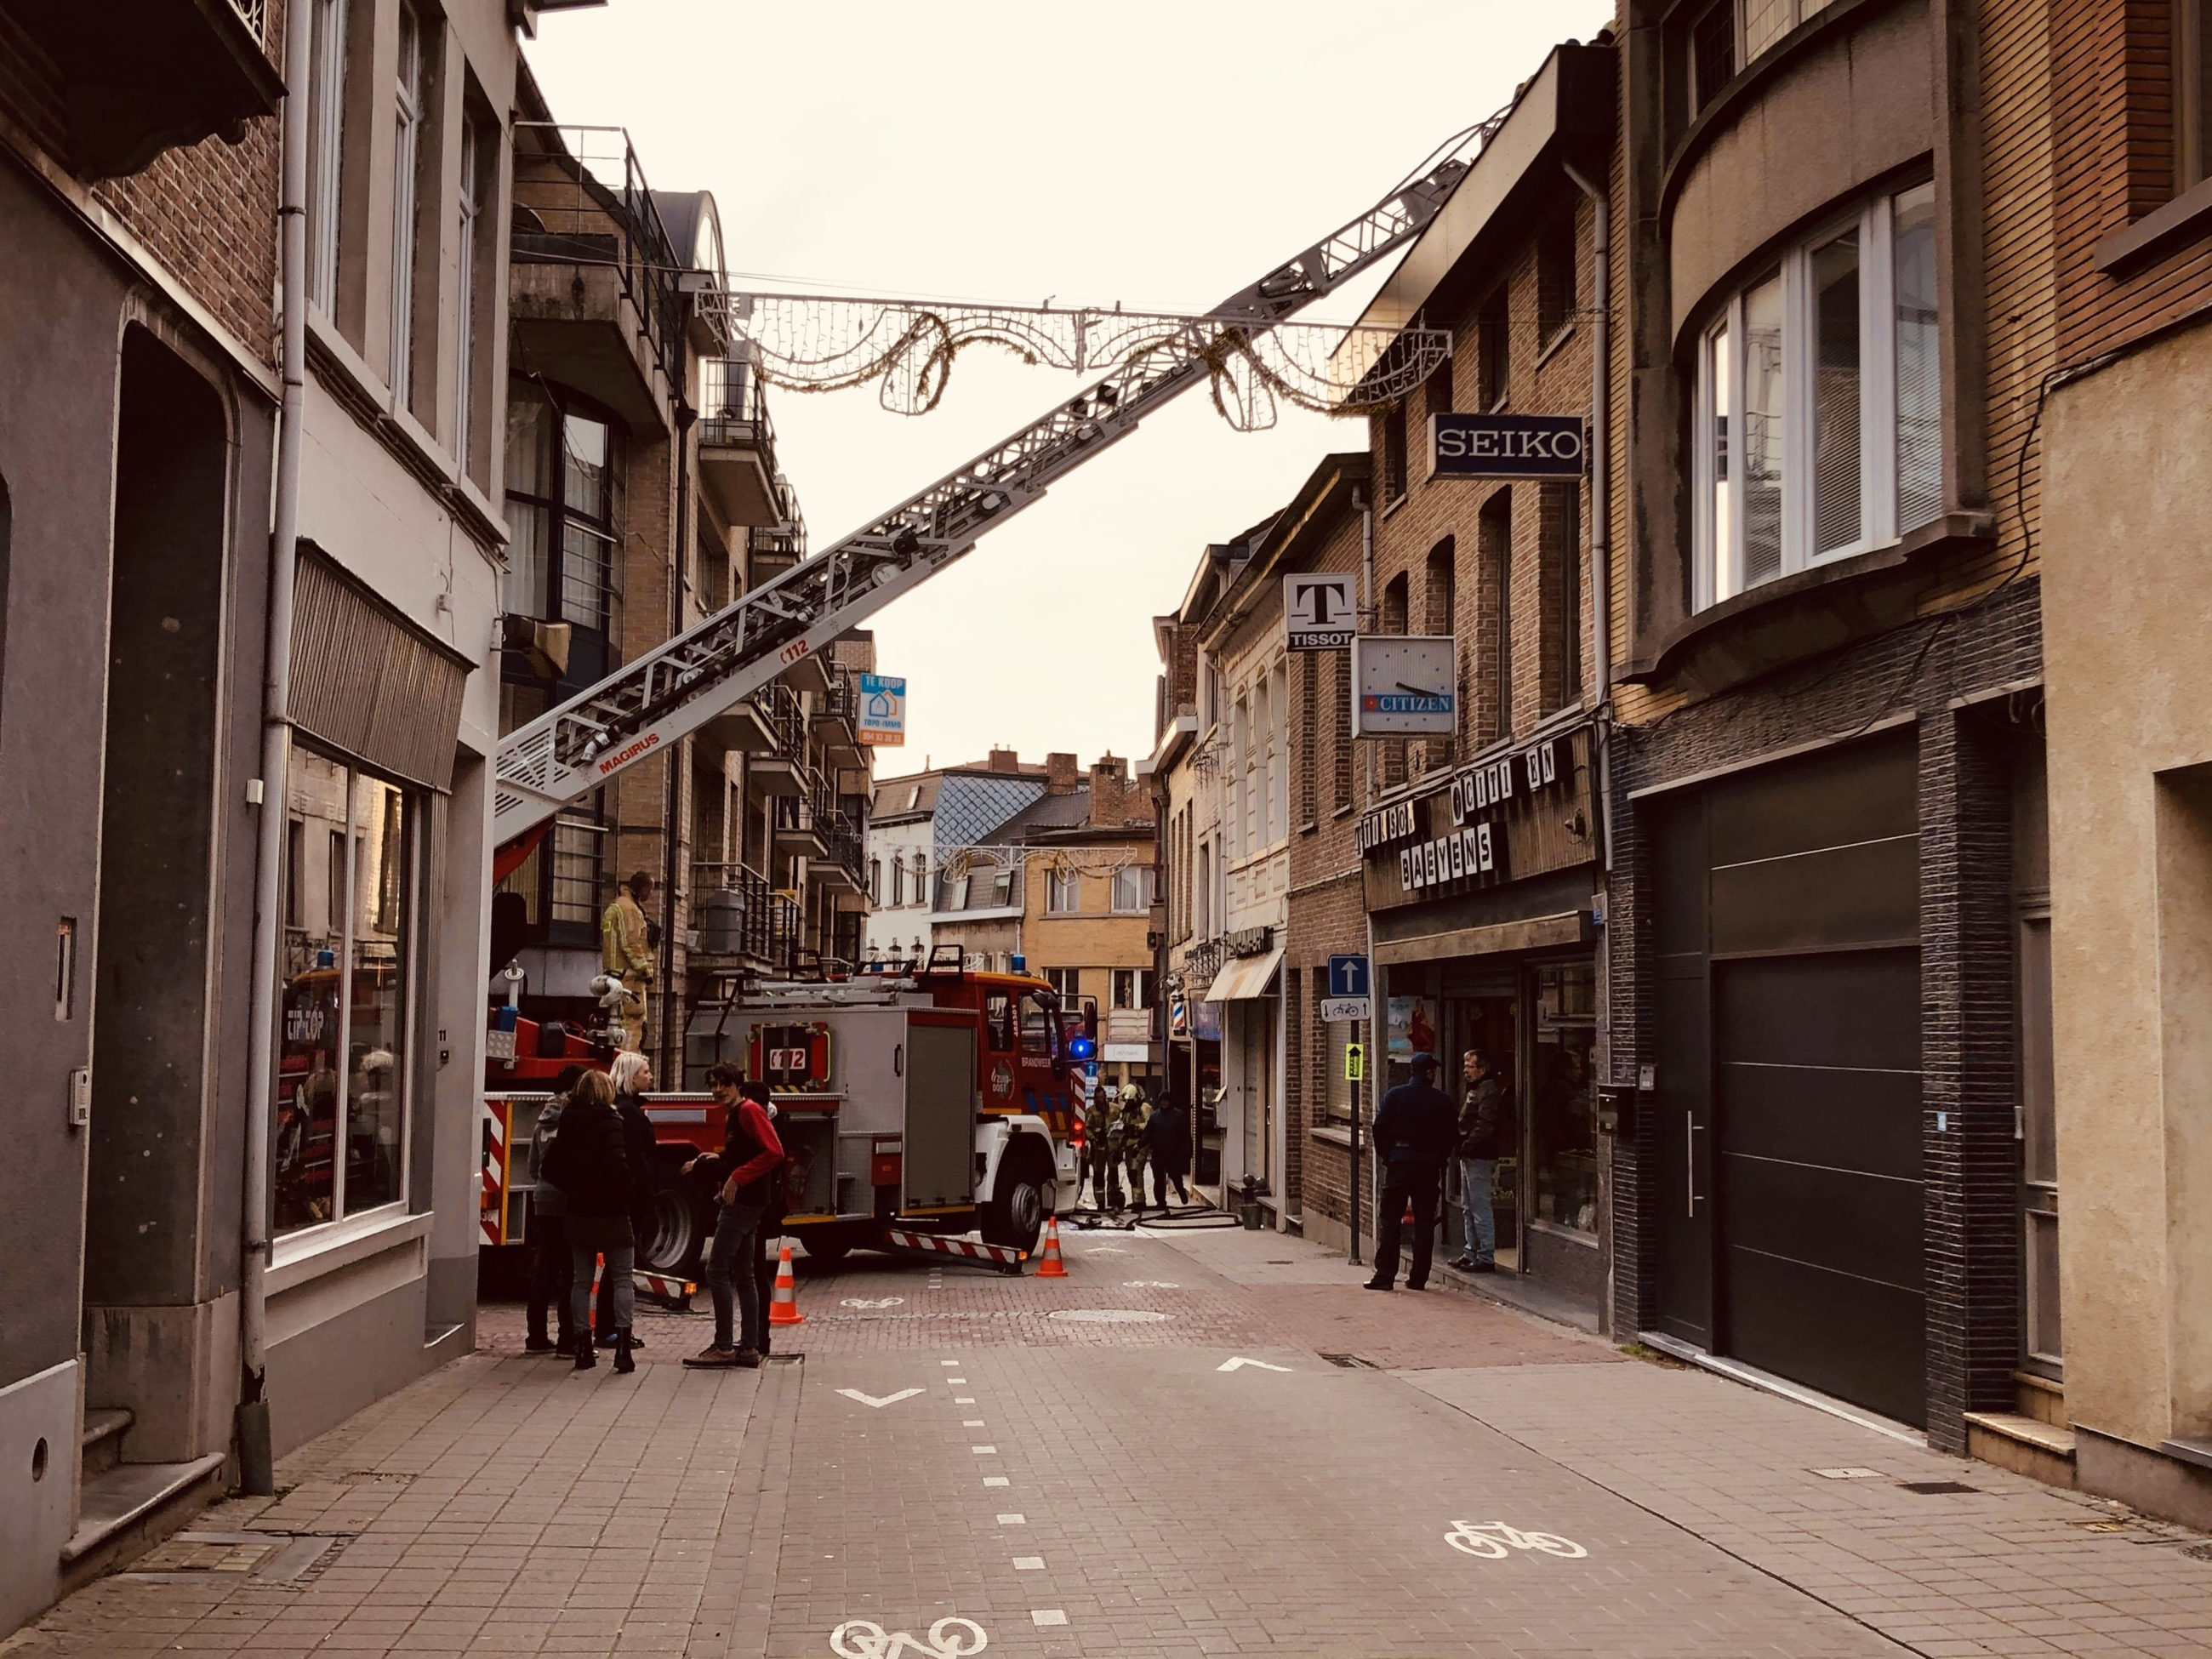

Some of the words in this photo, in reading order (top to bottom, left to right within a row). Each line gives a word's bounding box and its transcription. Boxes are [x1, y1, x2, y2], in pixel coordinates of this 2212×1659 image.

[1438, 429, 1582, 459] SEIKO
[1291, 632, 1354, 647] TISSOT
[785, 640, 810, 662] 112
[865, 676, 875, 687] TE
[879, 677, 903, 689] KOOP
[1380, 697, 1451, 712] CITIZEN
[599, 733, 660, 775] MAGIRUS
[1402, 832, 1490, 884] BAEYENS
[438, 1029, 447, 1042] 11
[993, 1084, 1006, 1092] OOST
